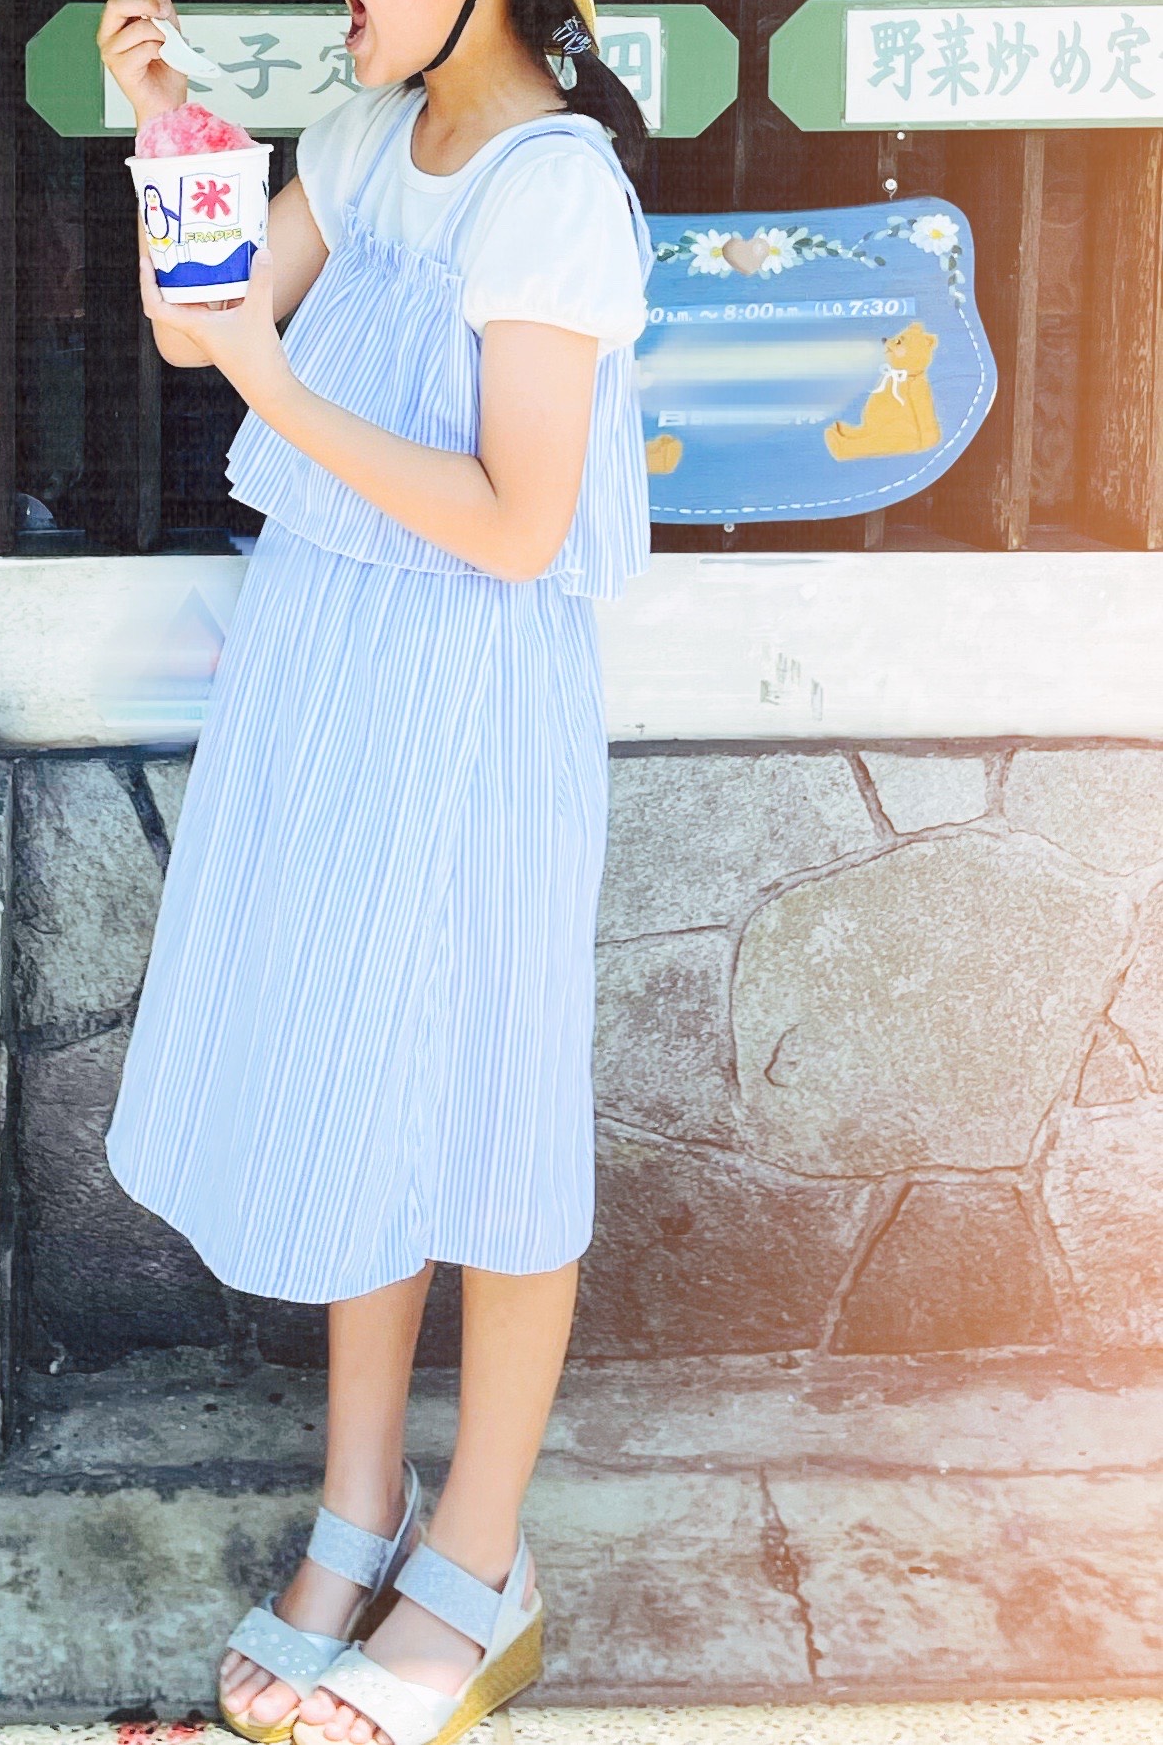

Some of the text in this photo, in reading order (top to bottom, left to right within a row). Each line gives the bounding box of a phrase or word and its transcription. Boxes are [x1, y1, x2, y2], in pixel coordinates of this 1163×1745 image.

[866, 12, 1158, 107] 野菜炒め定
[190, 179, 232, 220] 氷
[184, 228, 243, 244] FRAPPE
